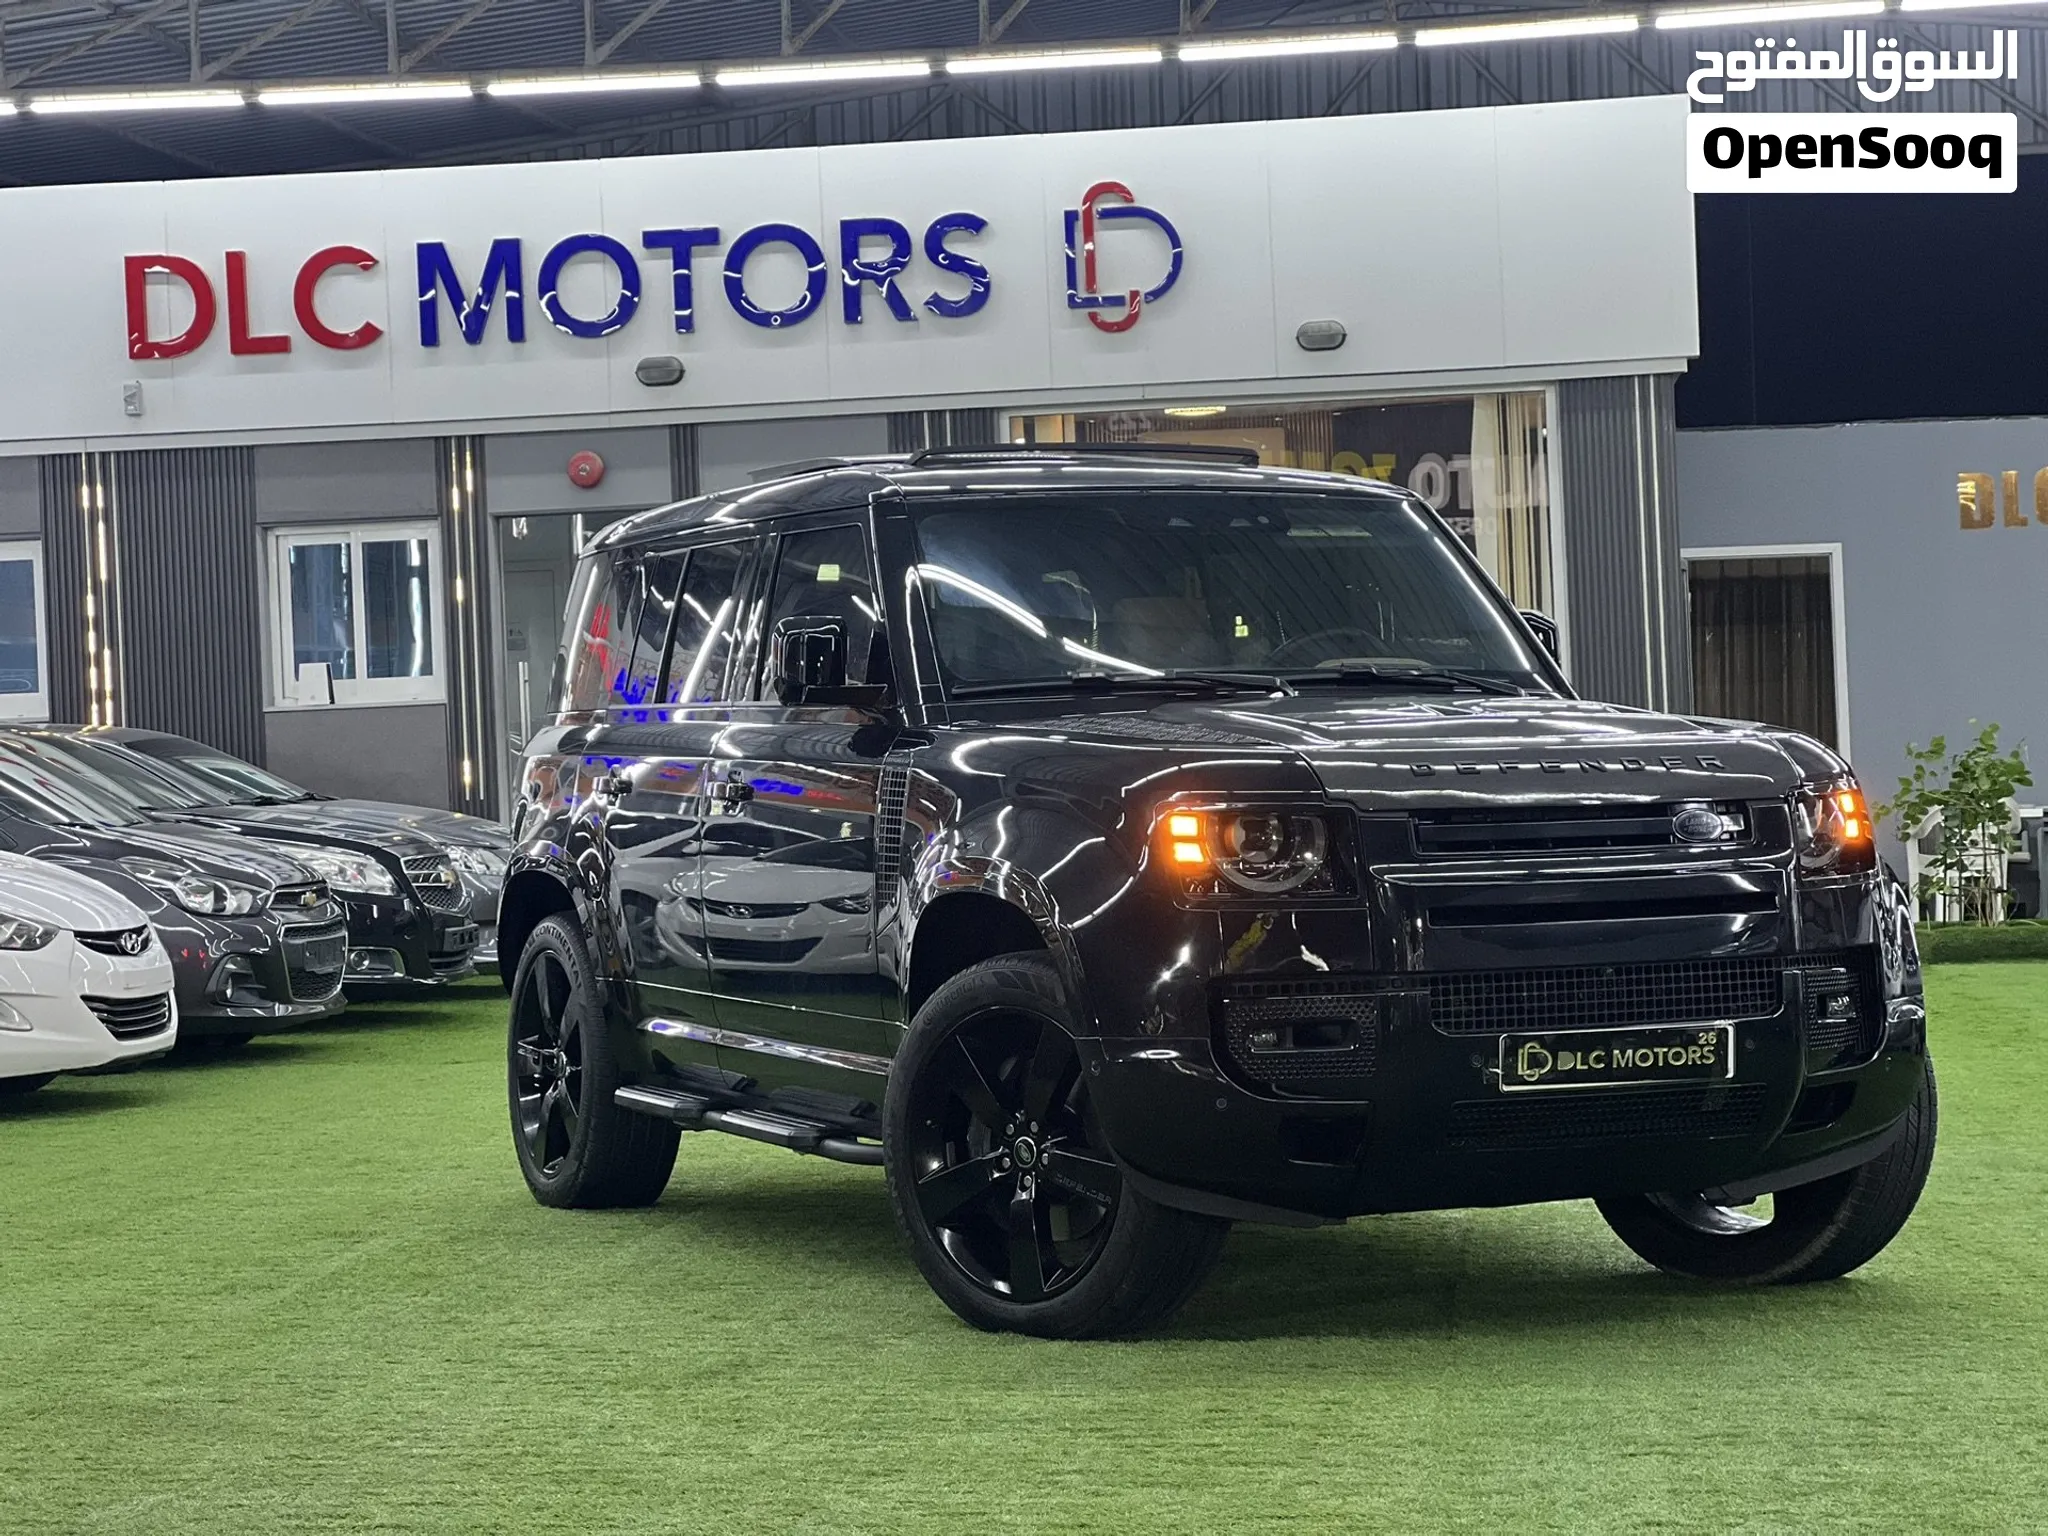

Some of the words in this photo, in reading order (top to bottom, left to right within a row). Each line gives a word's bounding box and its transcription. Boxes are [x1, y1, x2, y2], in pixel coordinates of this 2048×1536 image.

[124, 245, 383, 361] DLC
[416, 211, 992, 348] MOTORS
[1409, 755, 1725, 777] DEFENDER
[1557, 1051, 1606, 1071] DLC
[1612, 1046, 1716, 1069] MOTORS
